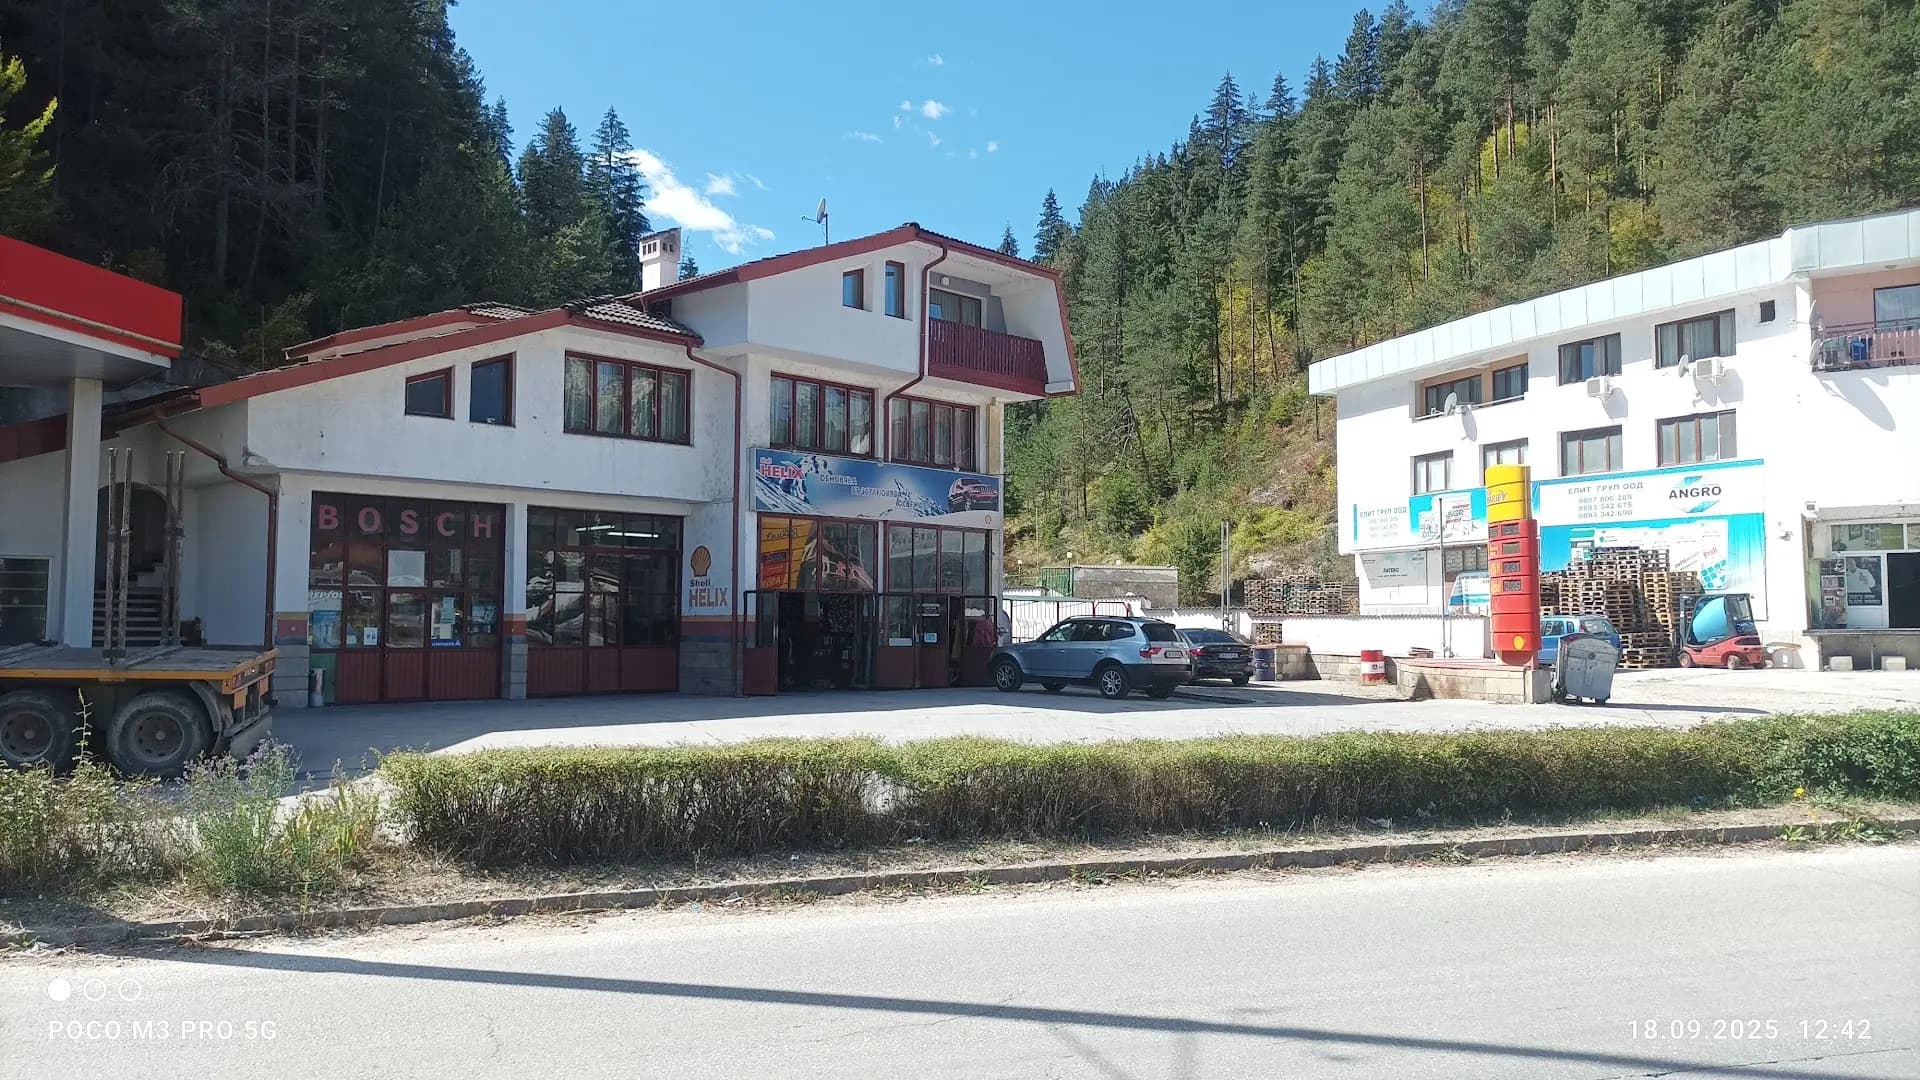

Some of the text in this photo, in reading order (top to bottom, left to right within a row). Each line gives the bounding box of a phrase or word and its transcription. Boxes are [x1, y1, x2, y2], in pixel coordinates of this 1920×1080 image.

[760, 464, 805, 480] HELIX
[1568, 482, 1644, 494] ЕЛИТ ГРУП ООД
[1669, 486, 1722, 499] ANGRO
[1393, 506, 1408, 514] ООД
[1600, 510, 1615, 518] 342
[319, 505, 492, 538] BOSCH
[689, 579, 711, 587] Shell
[689, 587, 728, 607] HELIX
